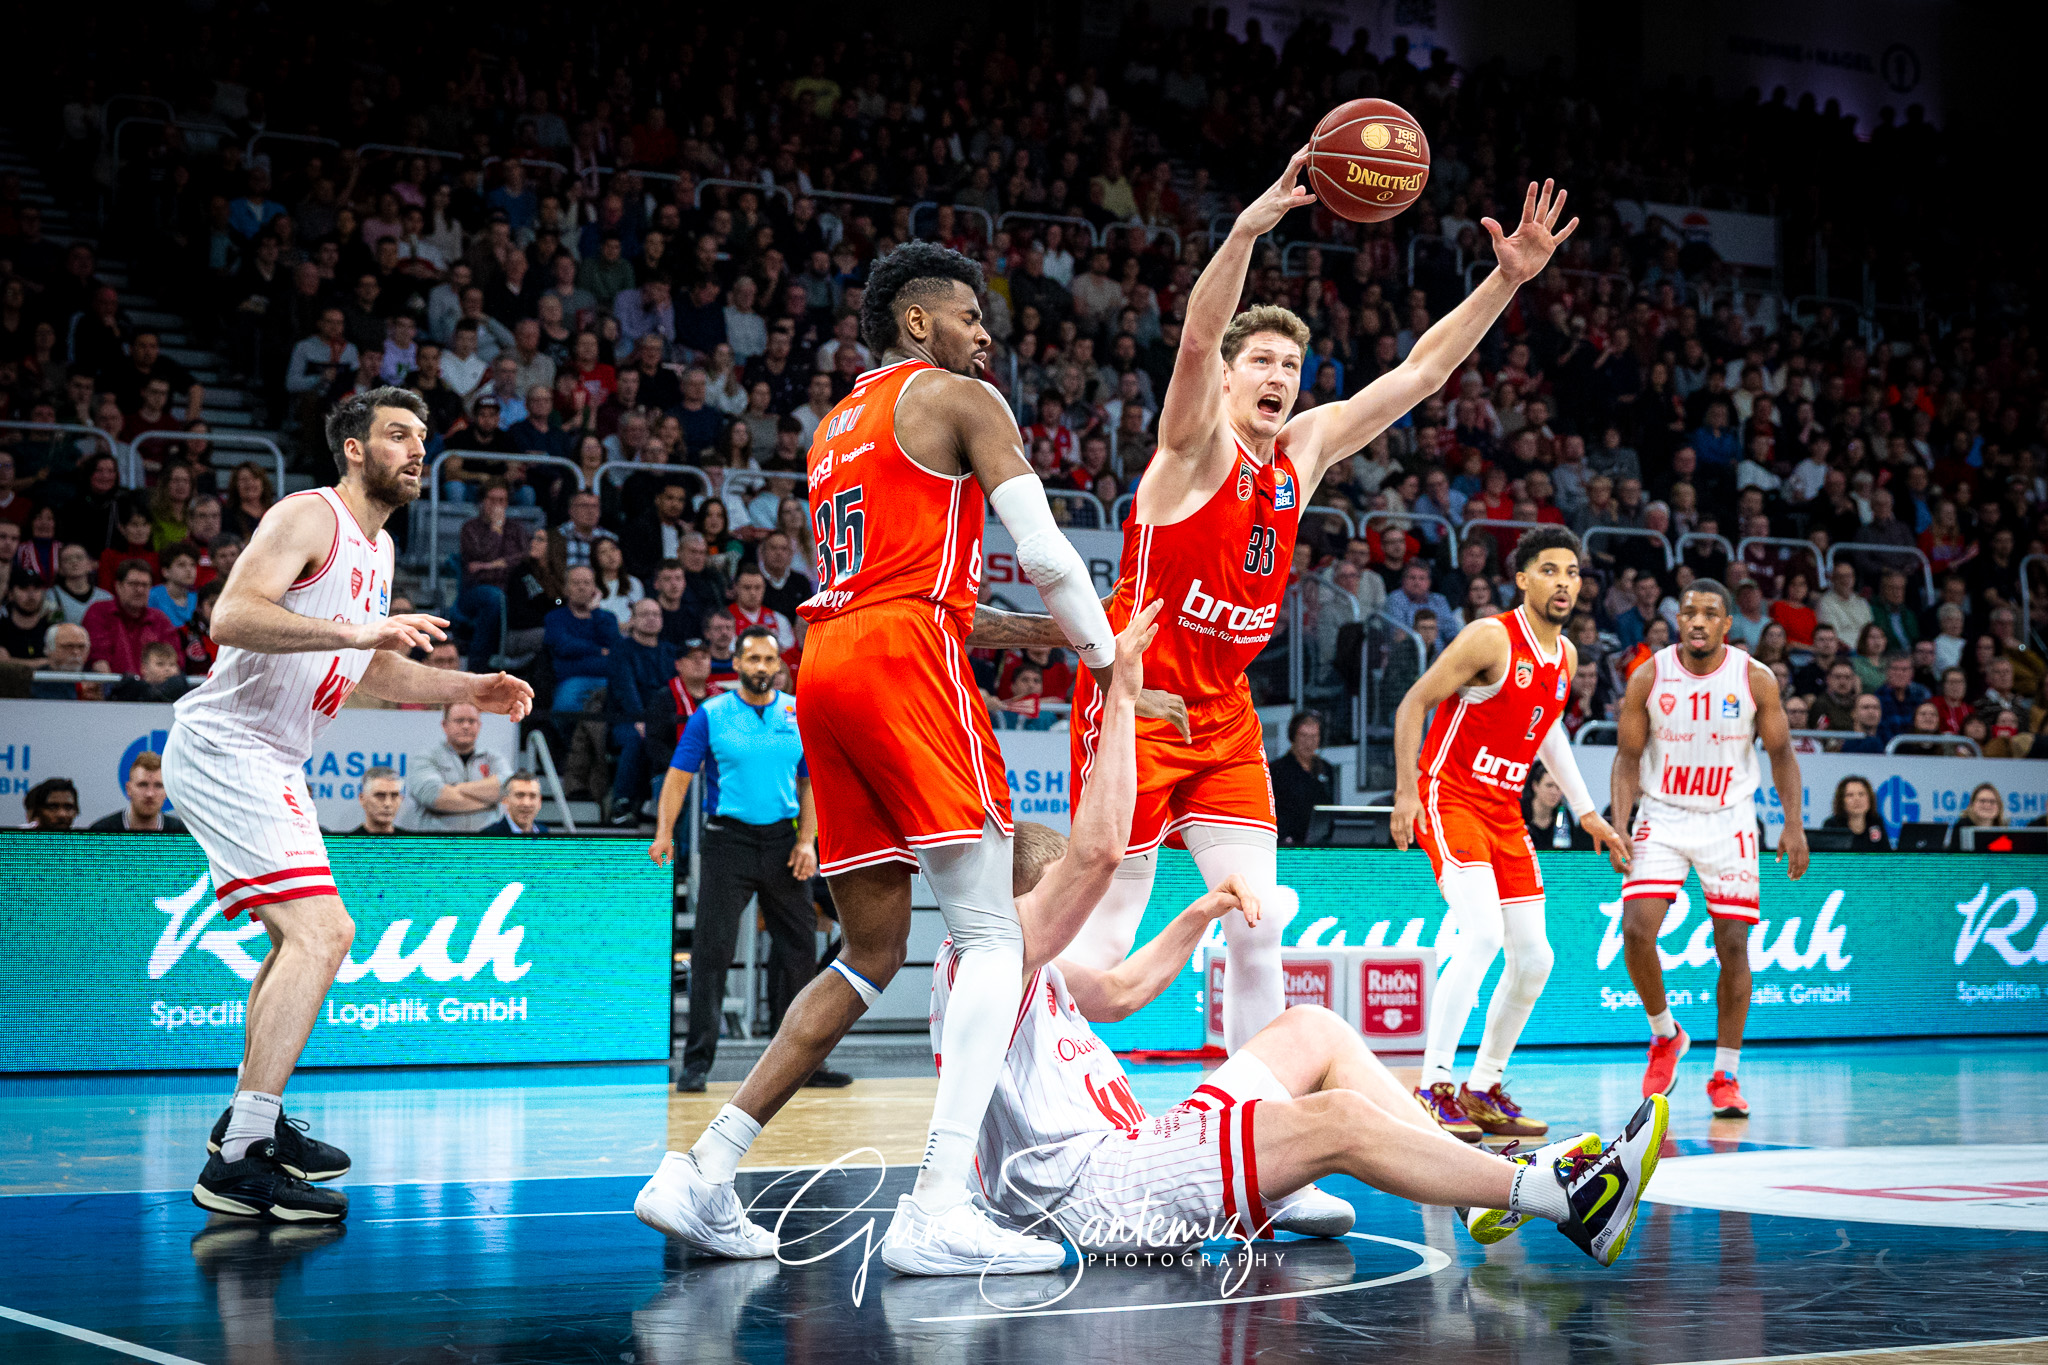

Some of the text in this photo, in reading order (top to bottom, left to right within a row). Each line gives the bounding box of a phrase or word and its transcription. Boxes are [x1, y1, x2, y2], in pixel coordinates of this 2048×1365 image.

[1394, 127, 1417, 142] BBL
[1347, 162, 1423, 191] SPALDING
[826, 404, 866, 442] ONU
[841, 442, 876, 463] logistics
[1275, 496, 1293, 507] BBL
[815, 484, 865, 594] 35
[1243, 525, 1277, 576] 33
[1181, 578, 1277, 631] brose
[1177, 615, 1217, 637] Technik
[1689, 691, 1711, 721] 11
[1524, 706, 1544, 741] 2
[1472, 745, 1530, 783] bro
[1660, 753, 1734, 806] KNAUF
[1734, 830, 1758, 860] 11
[1367, 968, 1418, 993] RHÖN
[327, 998, 429, 1030] Logistik
[438, 996, 528, 1023] GmbH
